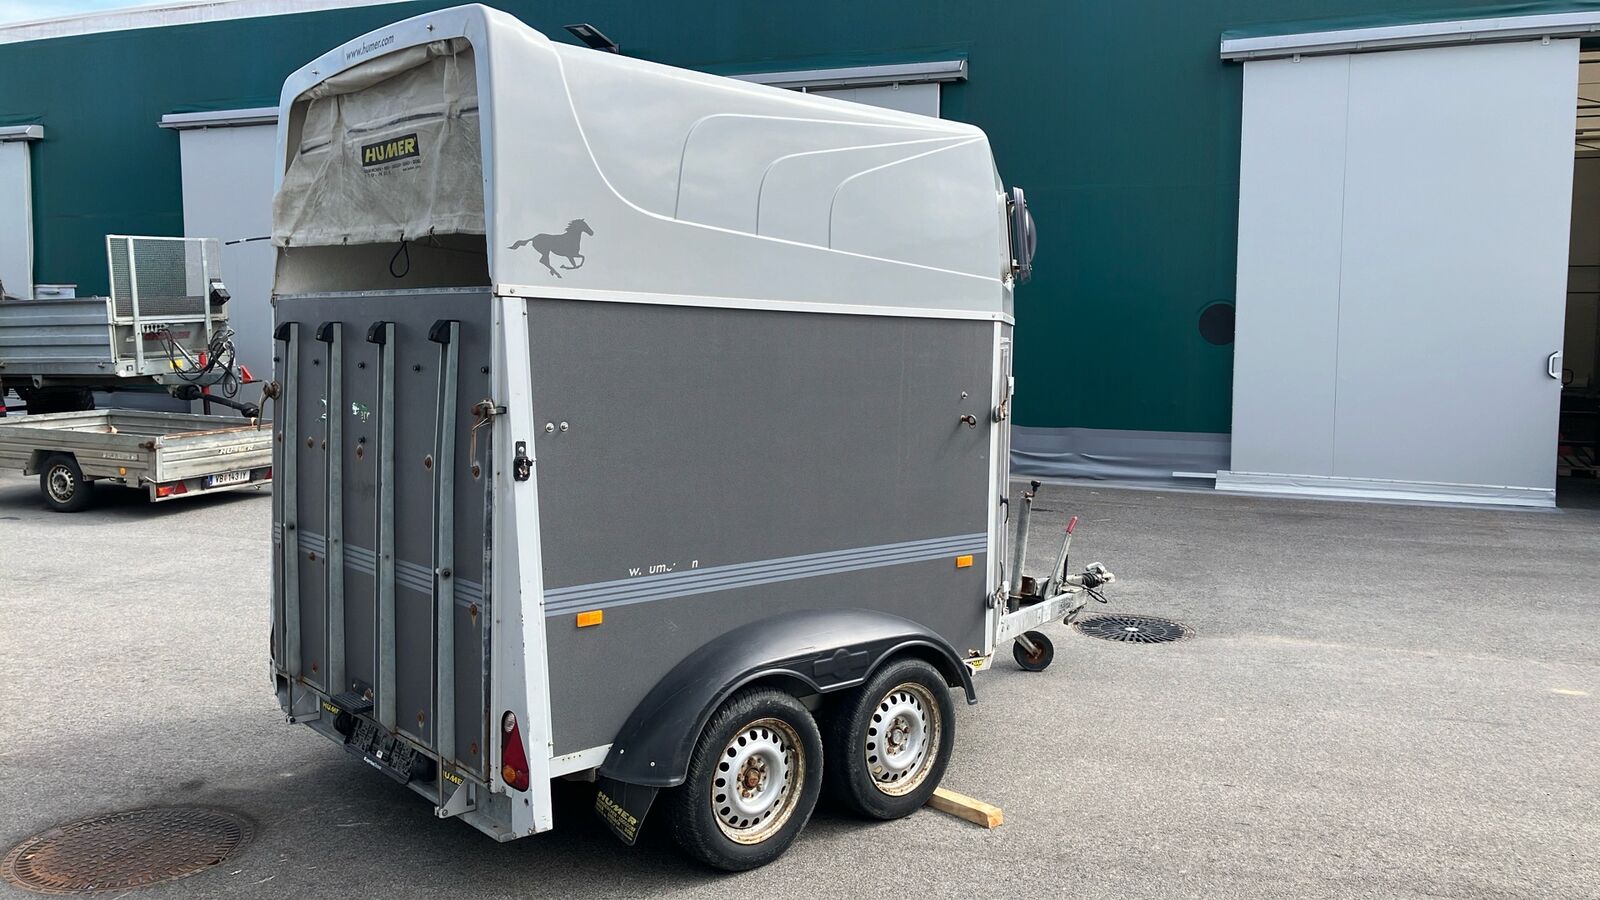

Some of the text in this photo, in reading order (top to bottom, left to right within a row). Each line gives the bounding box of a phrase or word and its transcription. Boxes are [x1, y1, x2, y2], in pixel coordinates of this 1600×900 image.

[345, 34, 395, 61] www.humer.com
[364, 138, 415, 163] HUMER
[597, 790, 637, 826] HUMER
